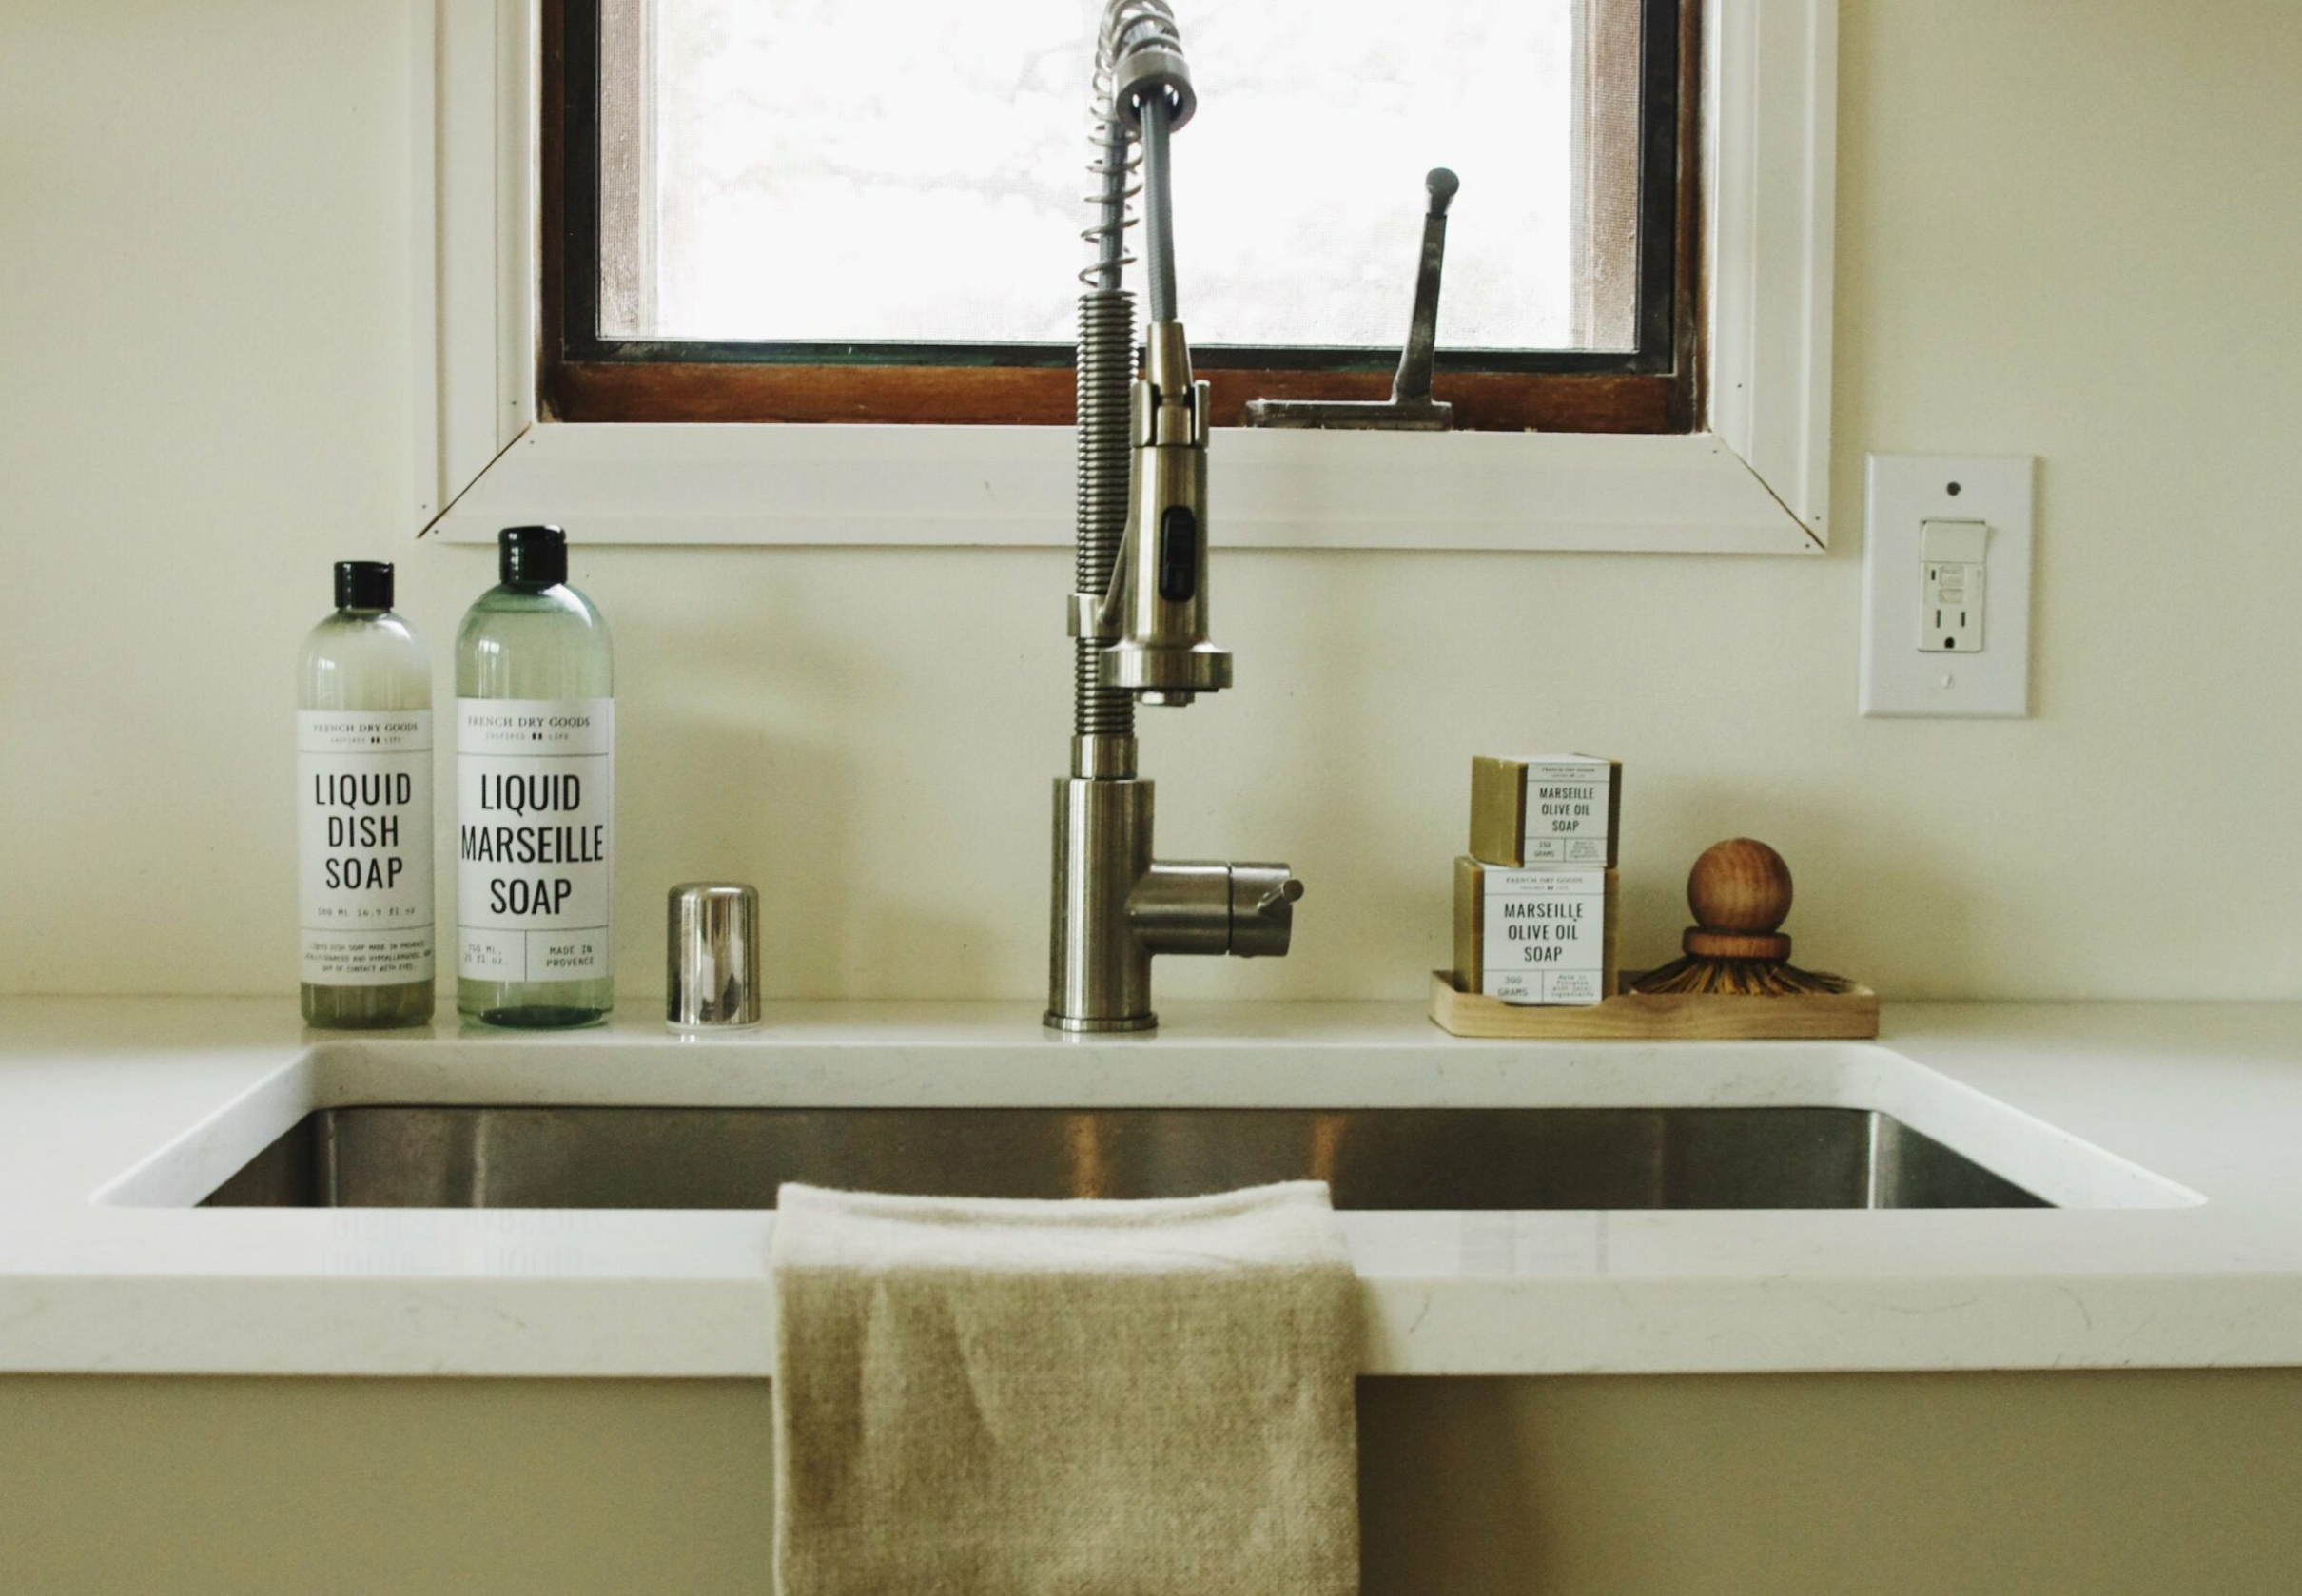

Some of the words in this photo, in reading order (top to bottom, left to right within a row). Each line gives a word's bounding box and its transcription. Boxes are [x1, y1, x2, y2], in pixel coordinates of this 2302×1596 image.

[314, 723, 355, 732] FRENCH
[359, 723, 381, 732] DRY
[384, 721, 418, 732] GOODS
[468, 715, 513, 728] FRENCH
[518, 716, 544, 728] DRY
[549, 715, 591, 728] GOODS
[315, 772, 412, 809] LIQUID
[481, 774, 581, 817] LIQUID
[1539, 787, 1595, 800] MARSEILLE
[1541, 803, 1571, 816] OLIVE
[1574, 804, 1590, 816] OIL
[328, 814, 400, 848] DISH
[1551, 819, 1580, 832] SOAP
[461, 824, 604, 864] MARSEILLE
[325, 857, 404, 890] SOAP
[490, 878, 572, 916] SOAP
[1504, 903, 1584, 919] MARSEILLE
[1508, 925, 1550, 940] OLIVE
[1555, 925, 1579, 941] OIL
[550, 945, 576, 956] MADE
[582, 944, 593, 954] IN
[1524, 945, 1563, 962] SOAP
[546, 956, 595, 967] PROVENCE
[1505, 976, 1522, 984] 300
[1497, 988, 1529, 997] GRAMS
